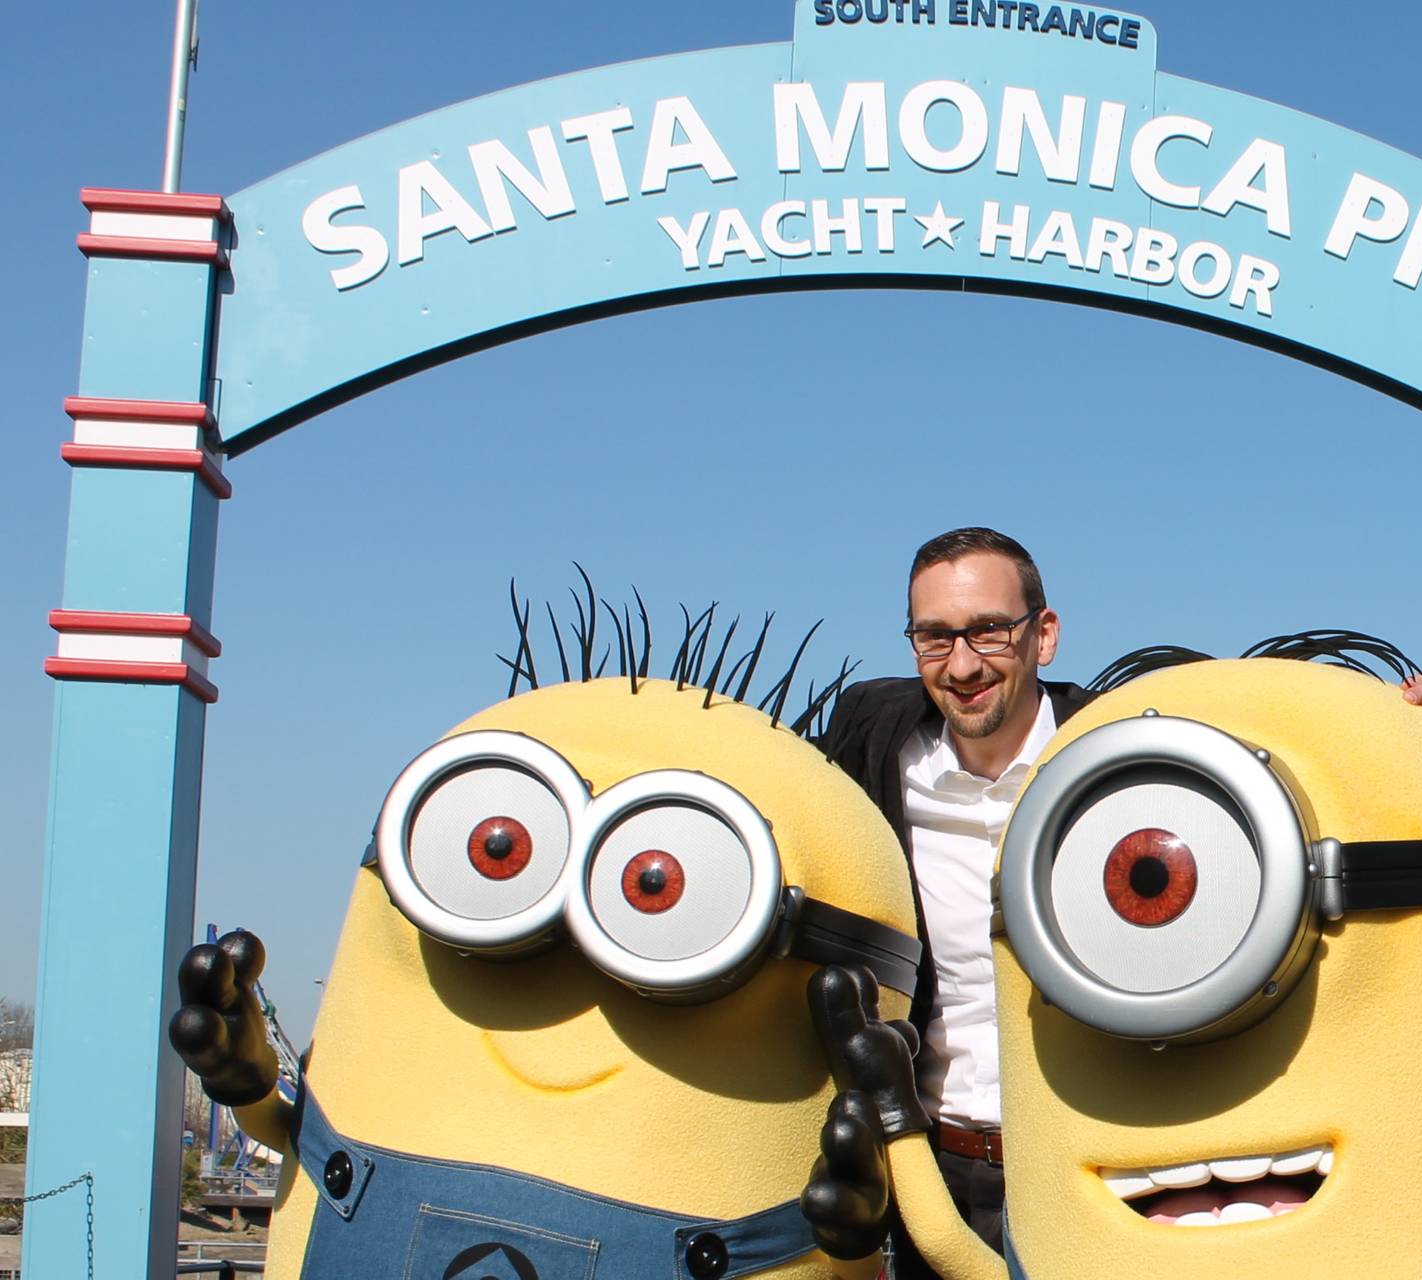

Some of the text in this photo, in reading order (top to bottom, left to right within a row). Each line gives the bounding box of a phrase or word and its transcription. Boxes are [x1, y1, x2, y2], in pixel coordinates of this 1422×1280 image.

[814, 0, 1141, 49] SOUTH ENTRANCE
[302, 96, 738, 291] SANTA
[773, 80, 1292, 239] MONICA
[657, 198, 1280, 317] YACHT HARBOR
